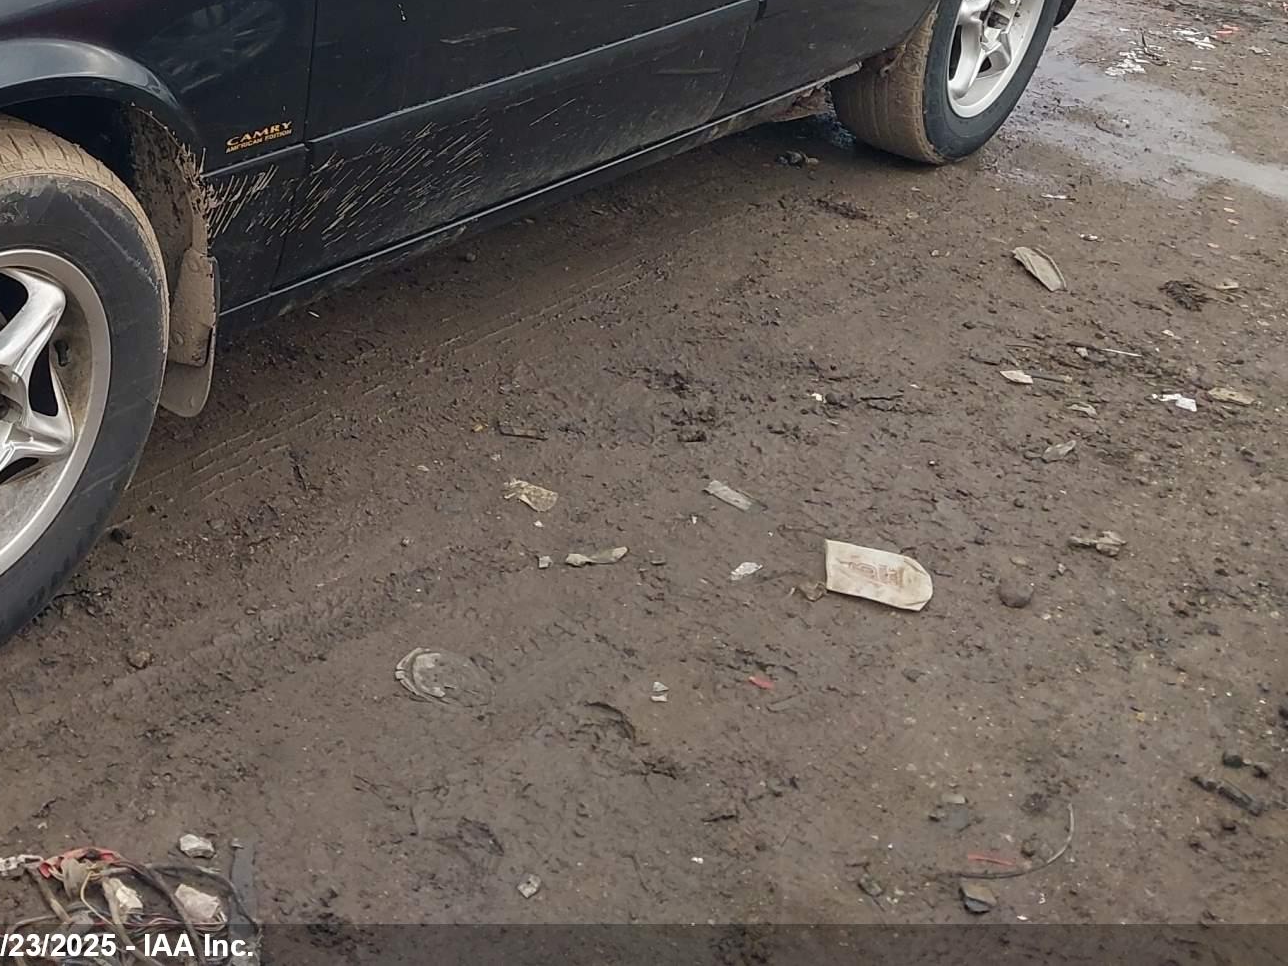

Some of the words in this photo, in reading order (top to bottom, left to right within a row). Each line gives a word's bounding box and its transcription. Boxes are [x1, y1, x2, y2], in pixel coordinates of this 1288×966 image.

[225, 138, 264, 154] AMERICAN
[264, 128, 292, 141] EDITION
[226, 120, 292, 146] CAMRY
